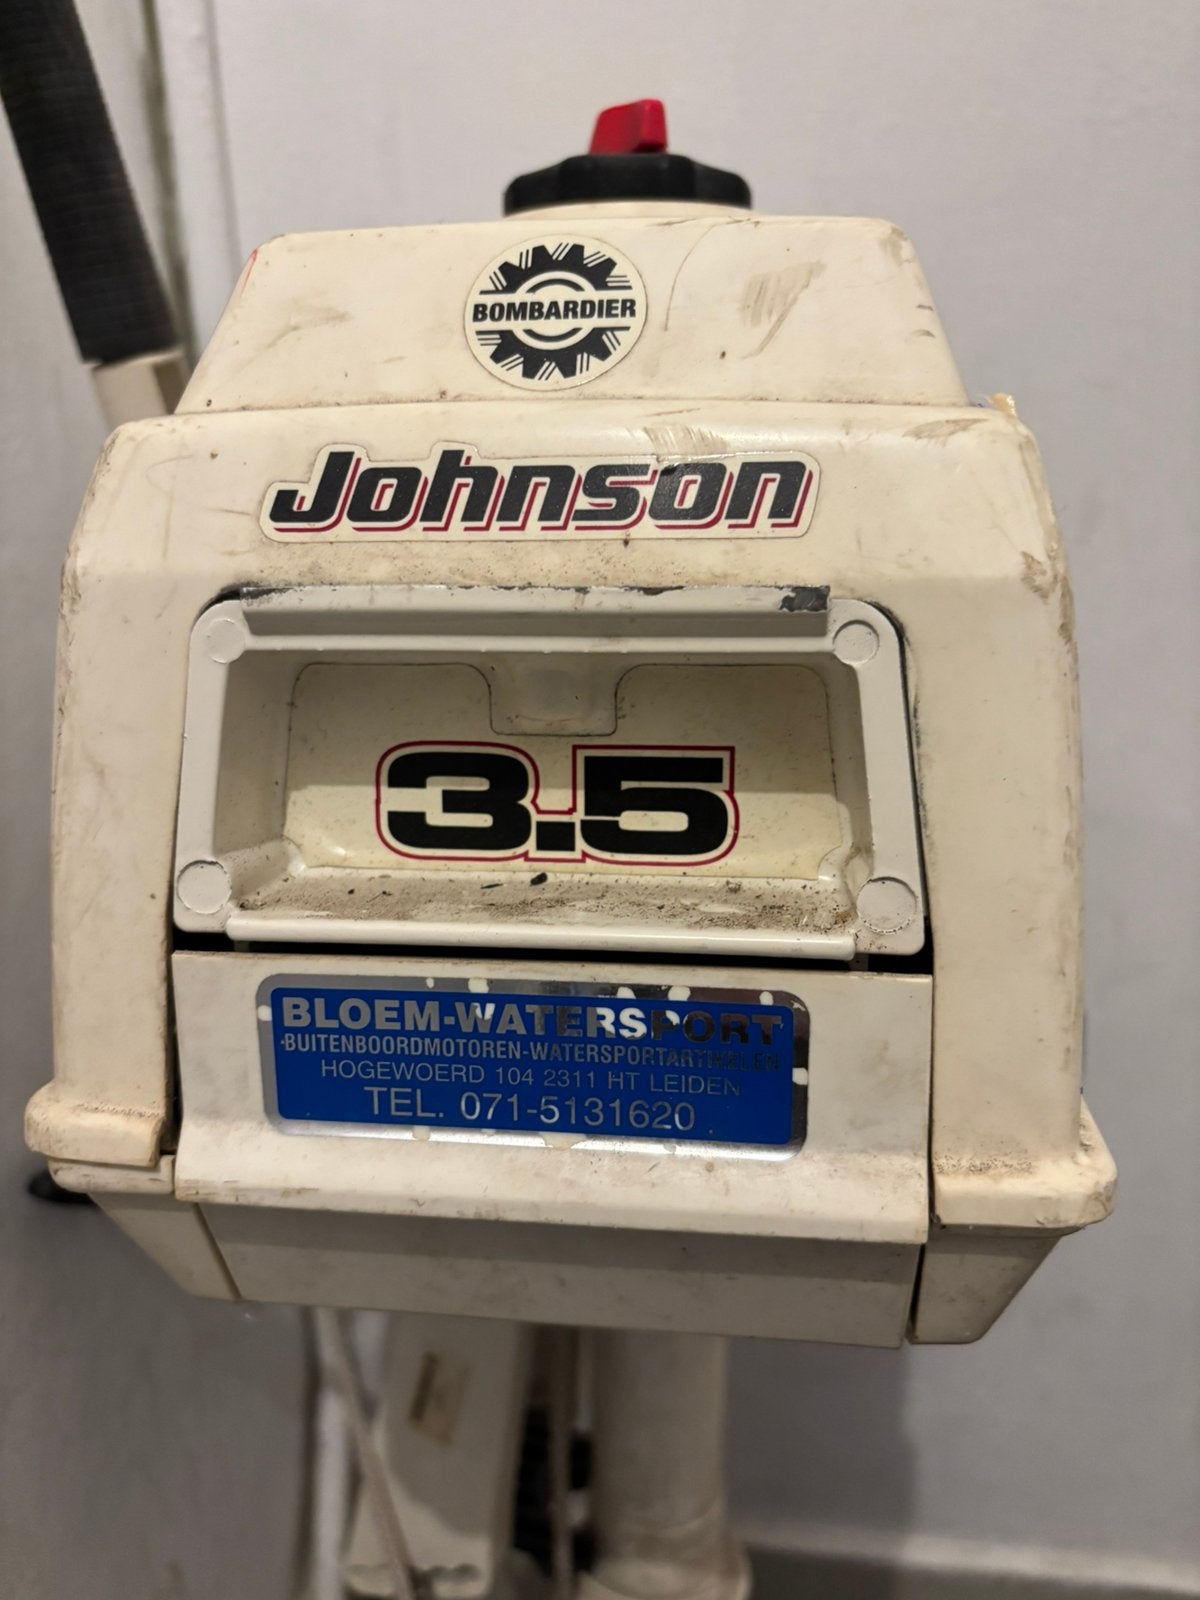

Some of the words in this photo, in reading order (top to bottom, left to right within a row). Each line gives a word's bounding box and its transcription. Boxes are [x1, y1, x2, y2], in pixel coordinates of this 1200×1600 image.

[472, 298, 636, 322] BOMBARDIER
[268, 449, 811, 531] Johnson
[386, 750, 730, 856] 3.5
[282, 996, 782, 1045] BLOEM-WATERSPORT
[320, 1059, 485, 1084] HOGEWOERD
[495, 1068, 535, 1086] 104
[543, 1069, 595, 1089] 2311
[607, 1071, 640, 1091] HT
[649, 1073, 741, 1097] LEIDEN
[363, 1086, 444, 1119] TEL.
[460, 1091, 696, 1131] 071-5131620
